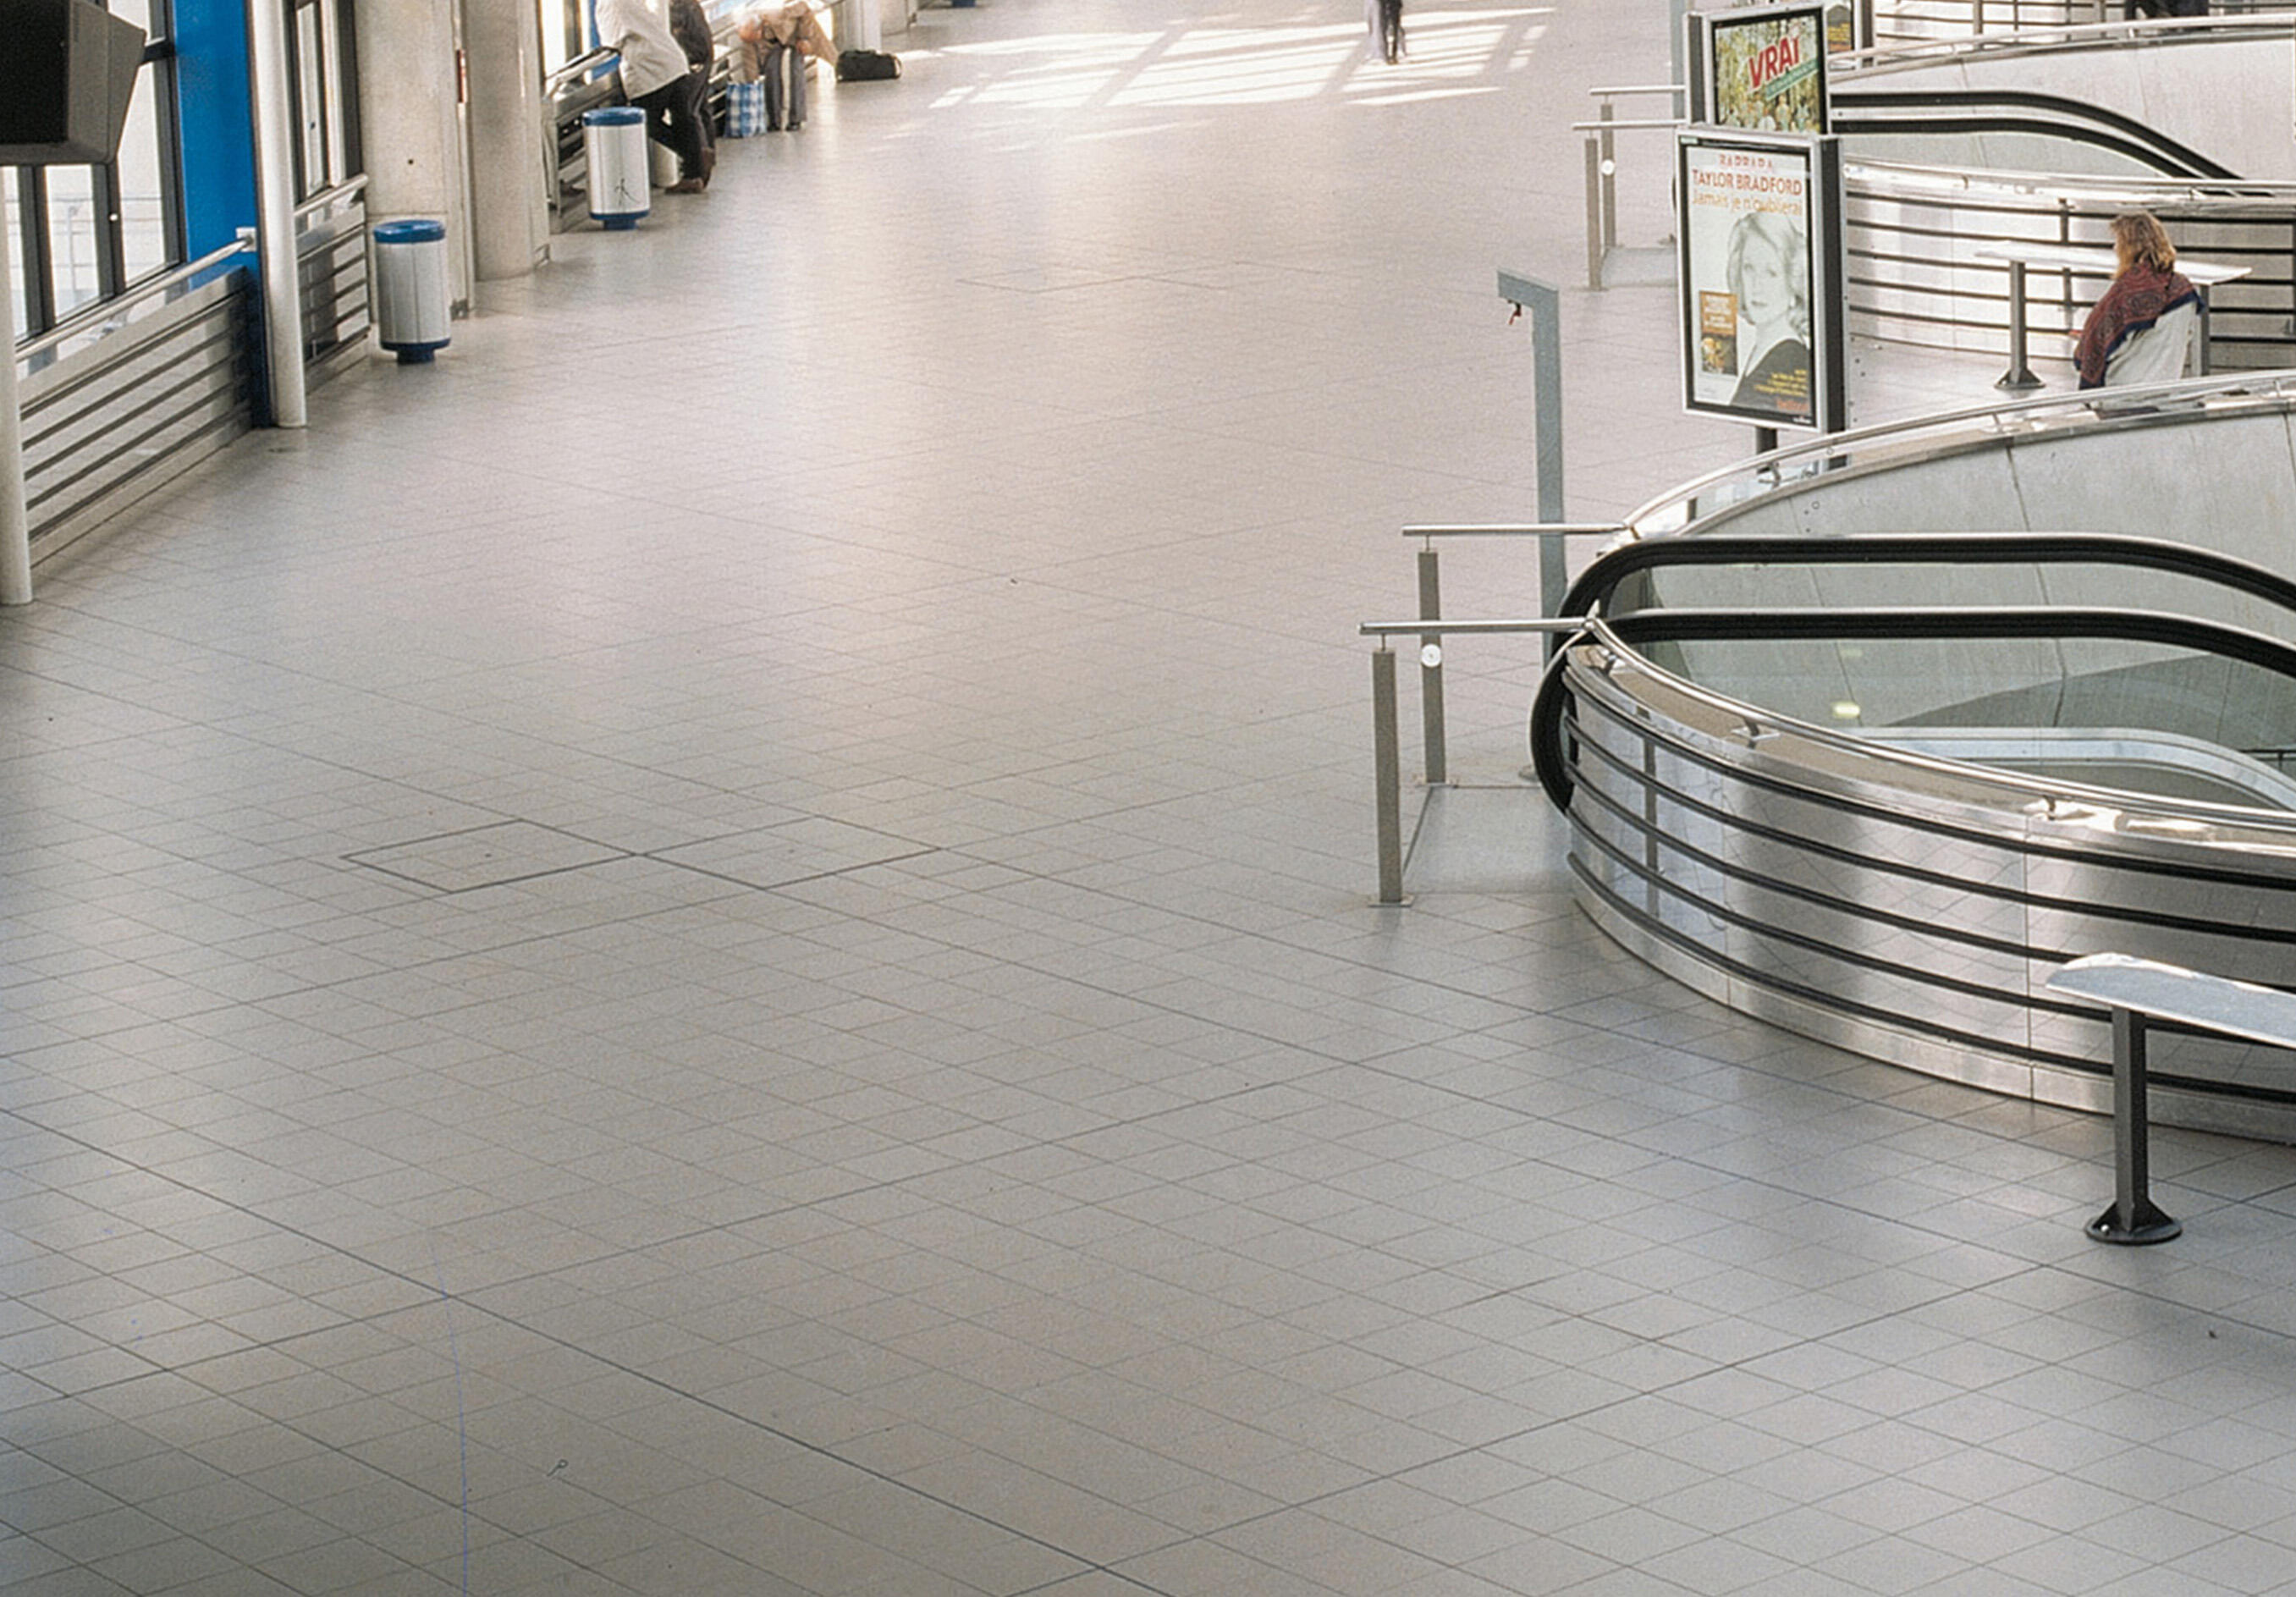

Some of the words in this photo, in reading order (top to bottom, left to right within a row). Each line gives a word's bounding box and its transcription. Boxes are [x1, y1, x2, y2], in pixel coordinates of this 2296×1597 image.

[1748, 37, 1799, 89] VRAI
[1693, 169, 1733, 188] TAYLOR
[1736, 173, 1803, 195] BRADFORD
